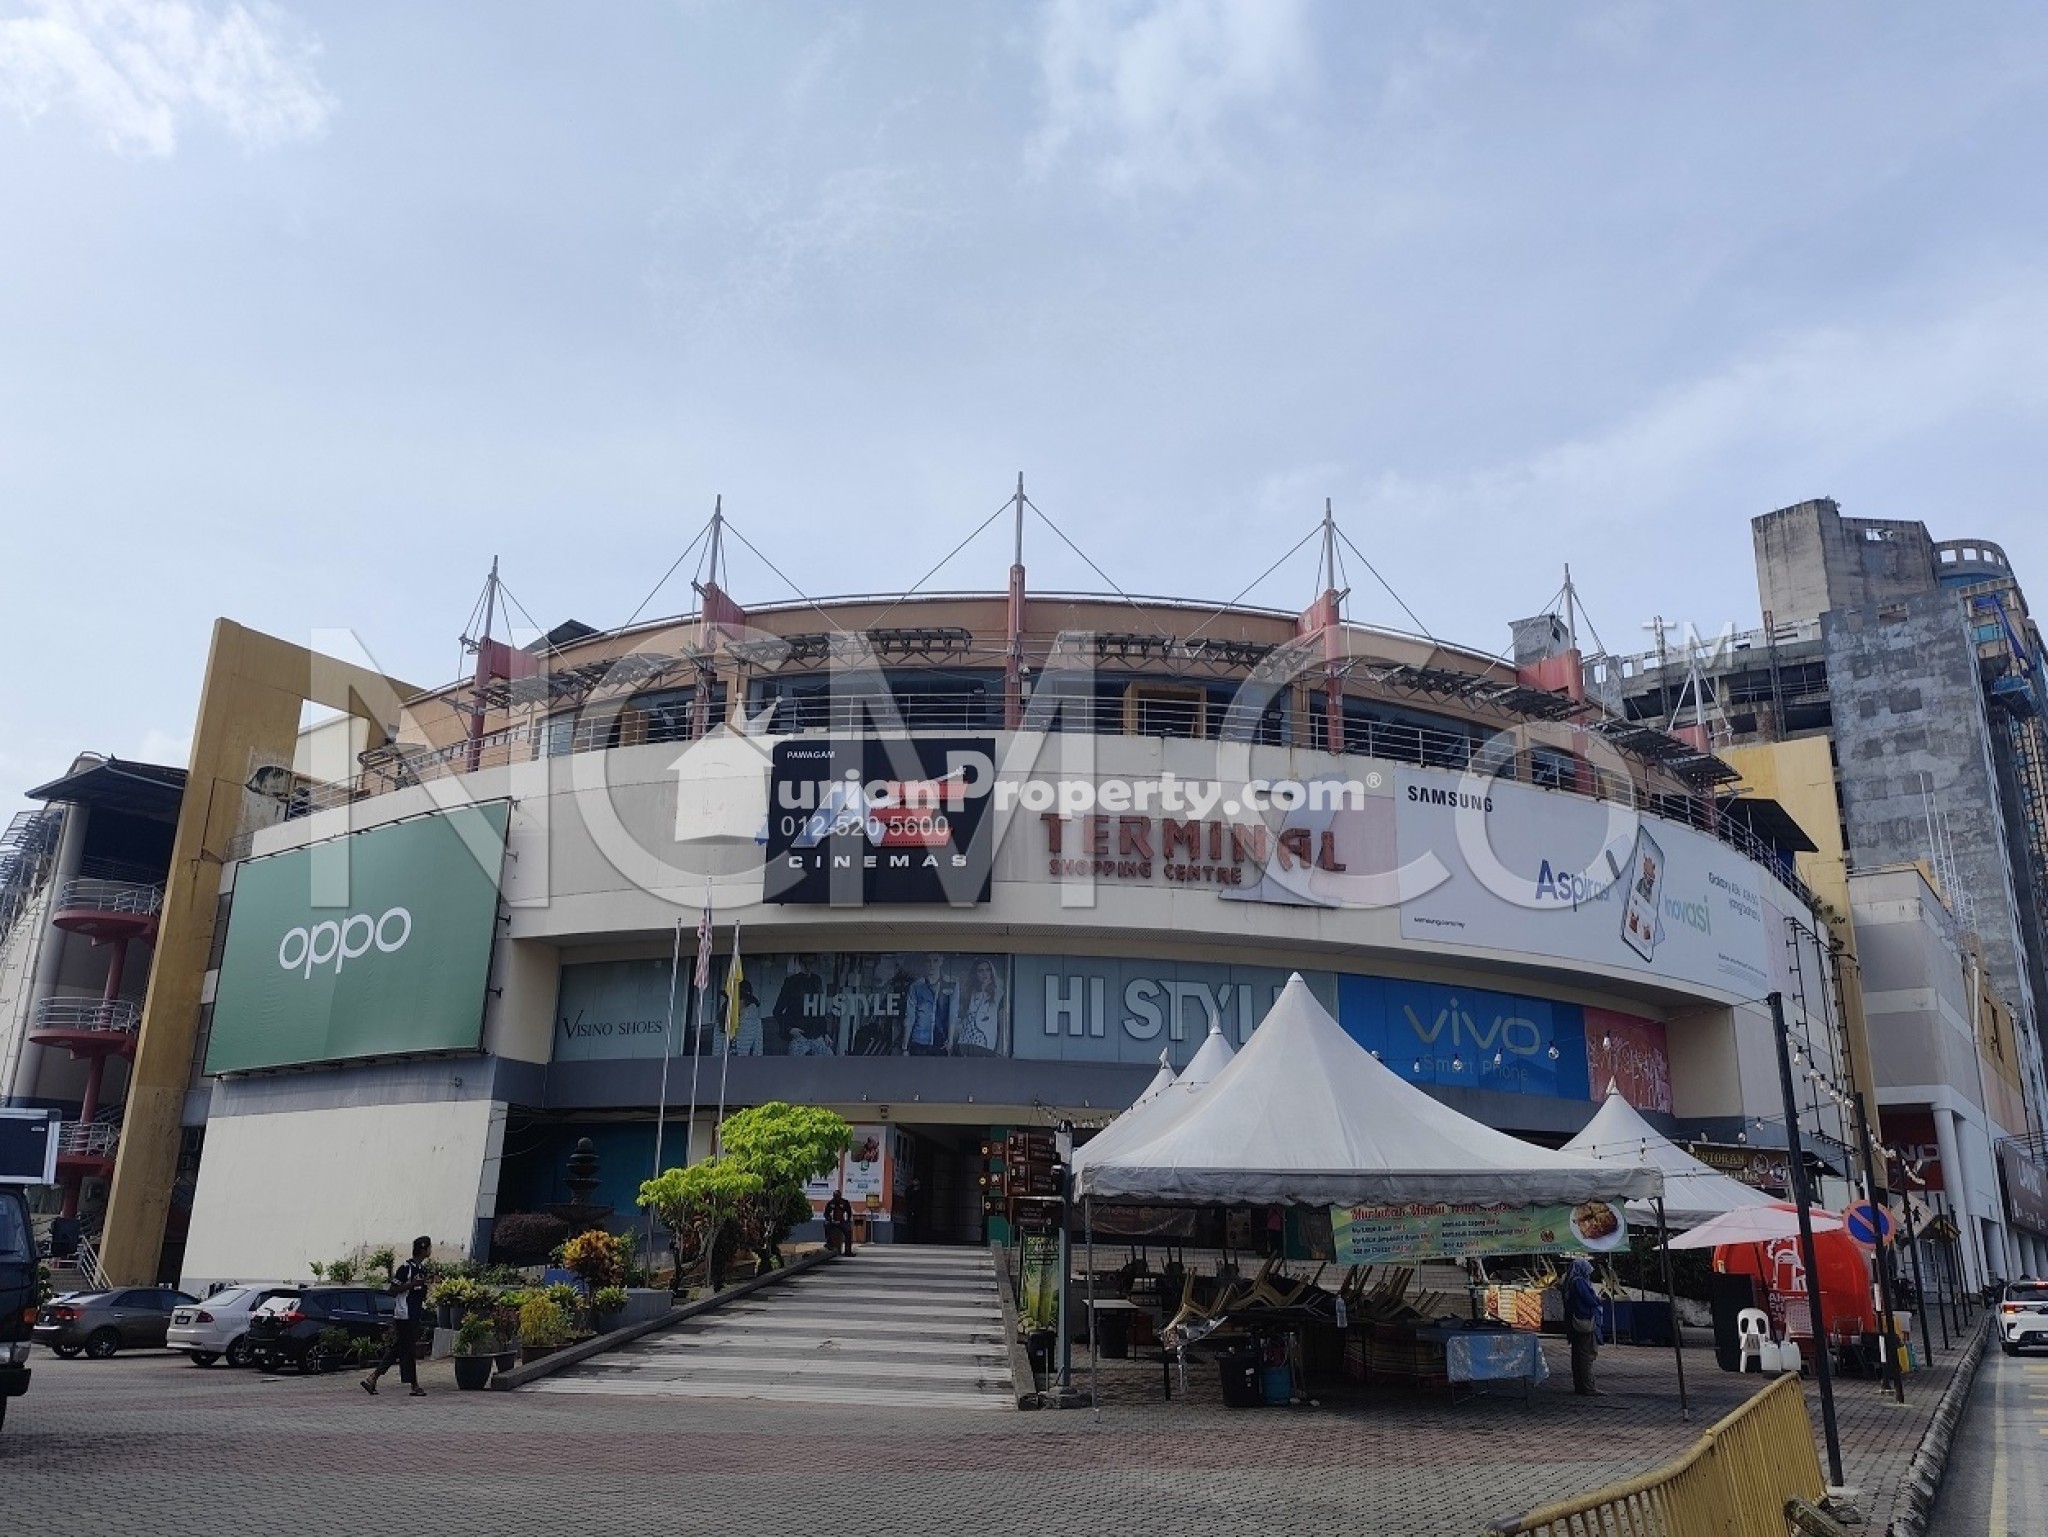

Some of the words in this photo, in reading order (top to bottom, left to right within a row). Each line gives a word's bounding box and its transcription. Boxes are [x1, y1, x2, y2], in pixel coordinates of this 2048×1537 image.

[786, 750, 836, 759] PAWAGAM
[1407, 784, 1493, 813] SAMSUNG
[1040, 813, 1347, 872] TERMINAL
[788, 854, 968, 868] CINEMAS
[1049, 858, 1152, 880] SHOPPING
[1163, 863, 1242, 885] CENTRE
[279, 906, 412, 980] oppo
[803, 992, 826, 1017] HI
[831, 992, 901, 1017] STYLE
[1044, 974, 1106, 1038] HI
[1122, 977, 1283, 1044] STYL
[618, 1020, 663, 1036] SHOES
[1403, 997, 1541, 1056] vivo
[1481, 1060, 1529, 1081] Phone
